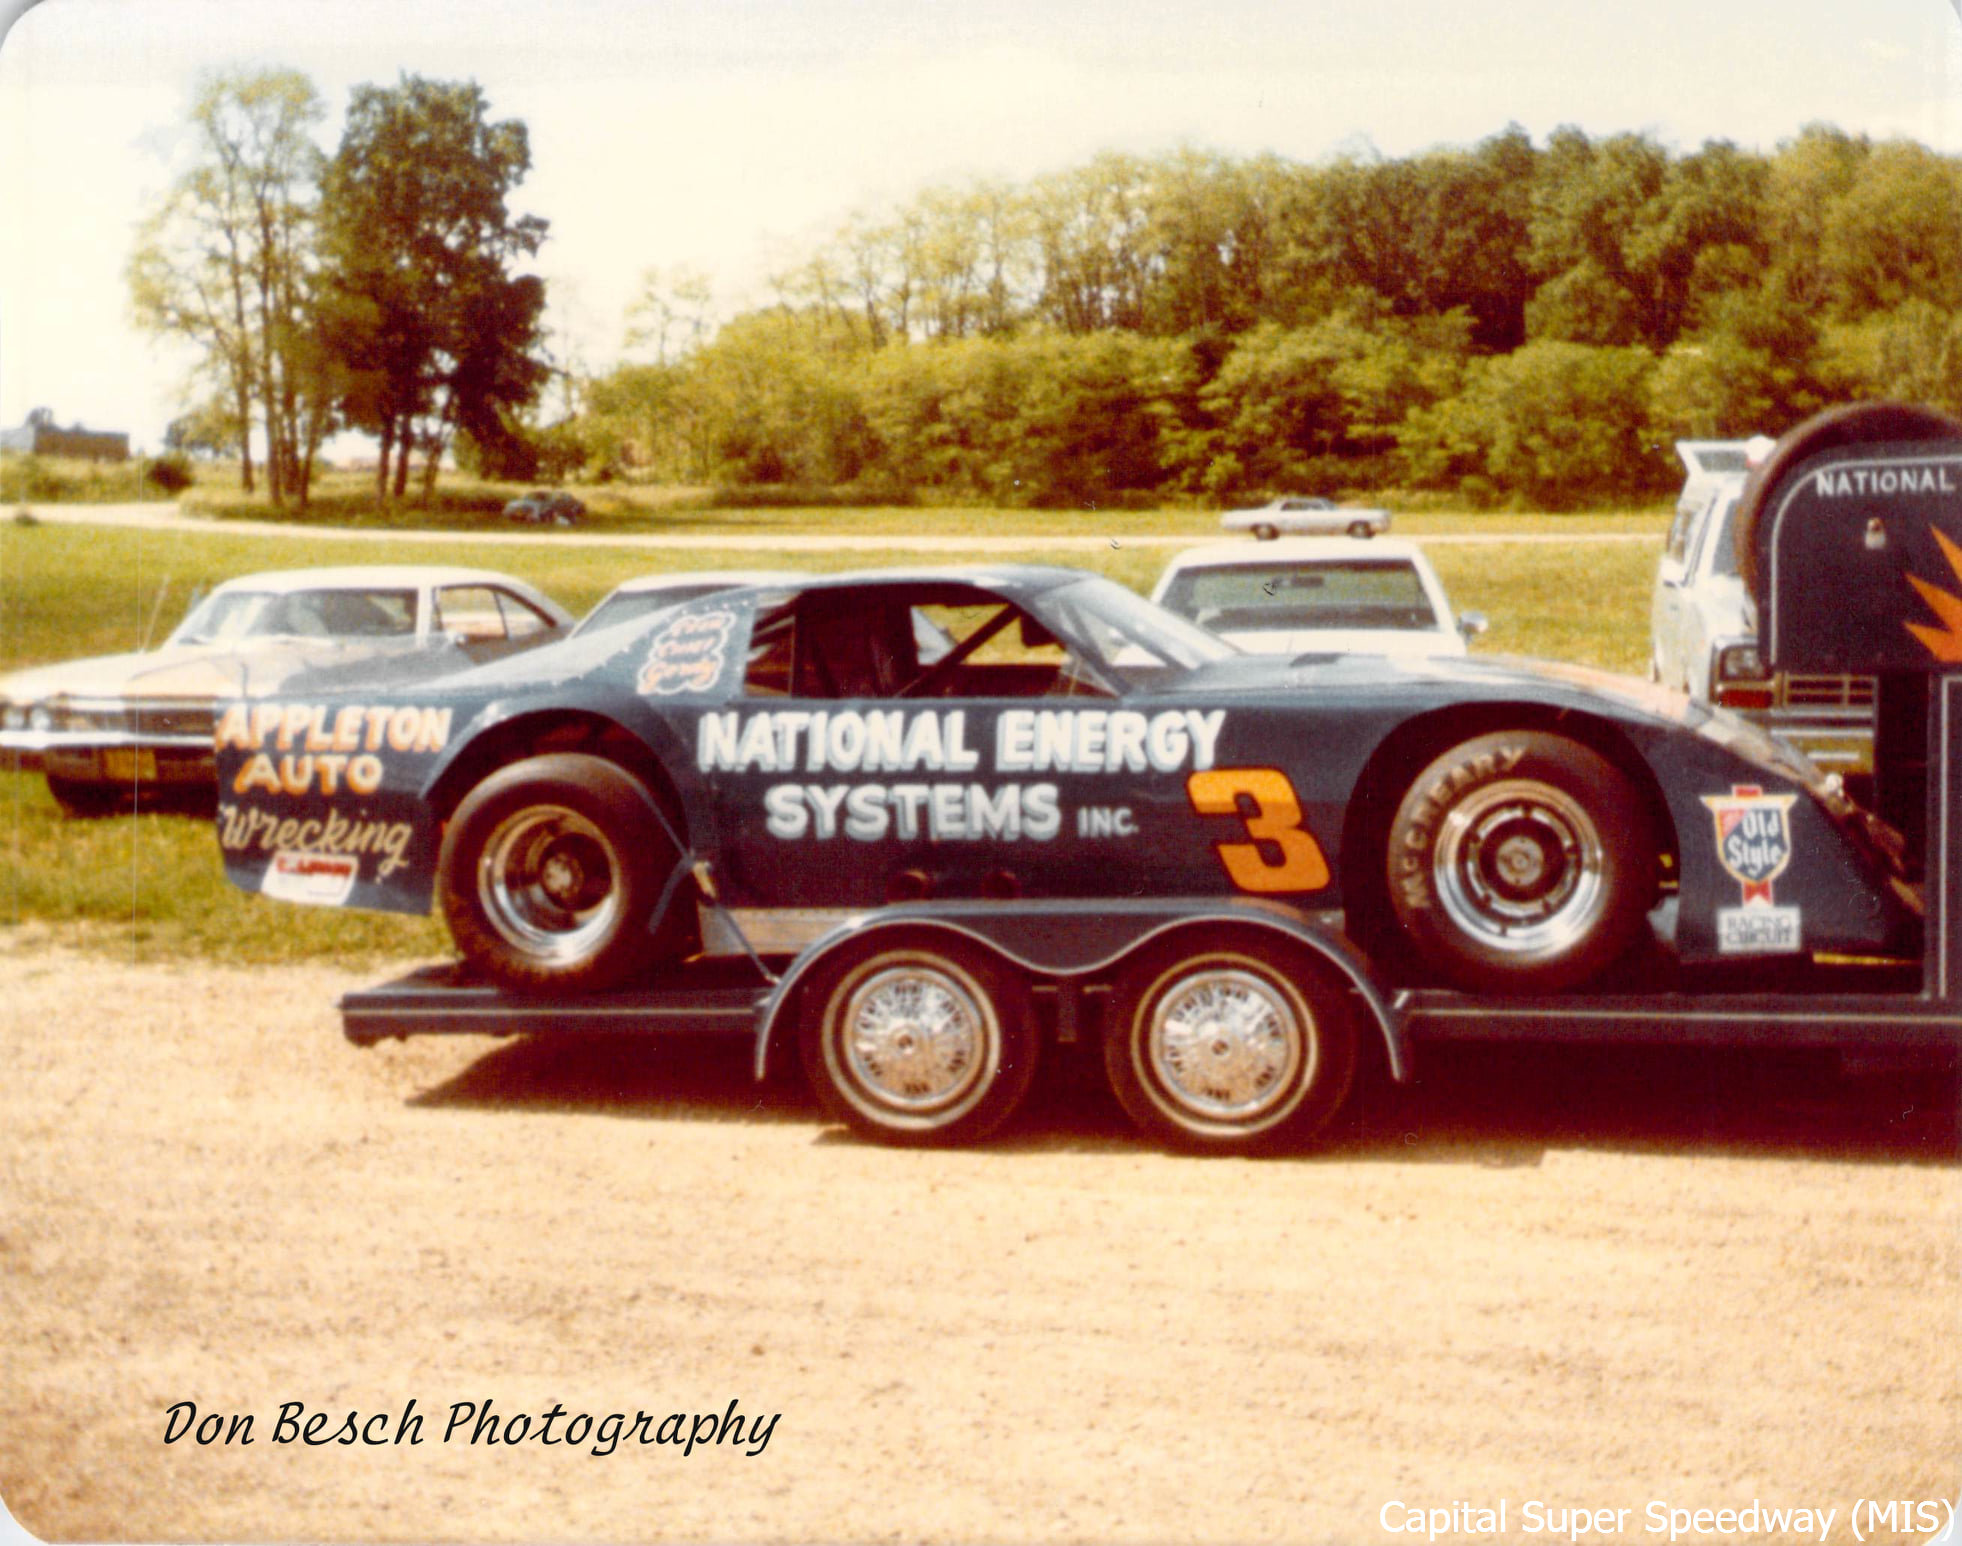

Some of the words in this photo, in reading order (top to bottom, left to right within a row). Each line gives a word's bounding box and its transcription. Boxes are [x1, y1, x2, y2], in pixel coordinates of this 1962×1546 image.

[1814, 466, 1957, 498] NATIONAL
[215, 703, 452, 752] APPLETON
[698, 708, 979, 773] NATIONAL
[995, 708, 1227, 773] ENERGY
[233, 754, 383, 795] AUTO
[764, 783, 1061, 841] SYSTEMS
[1077, 807, 1140, 839] INC.
[1186, 768, 1331, 893] 3
[1742, 811, 1780, 839] Old
[218, 804, 413, 884] Wrecking
[1727, 834, 1783, 877] Style
